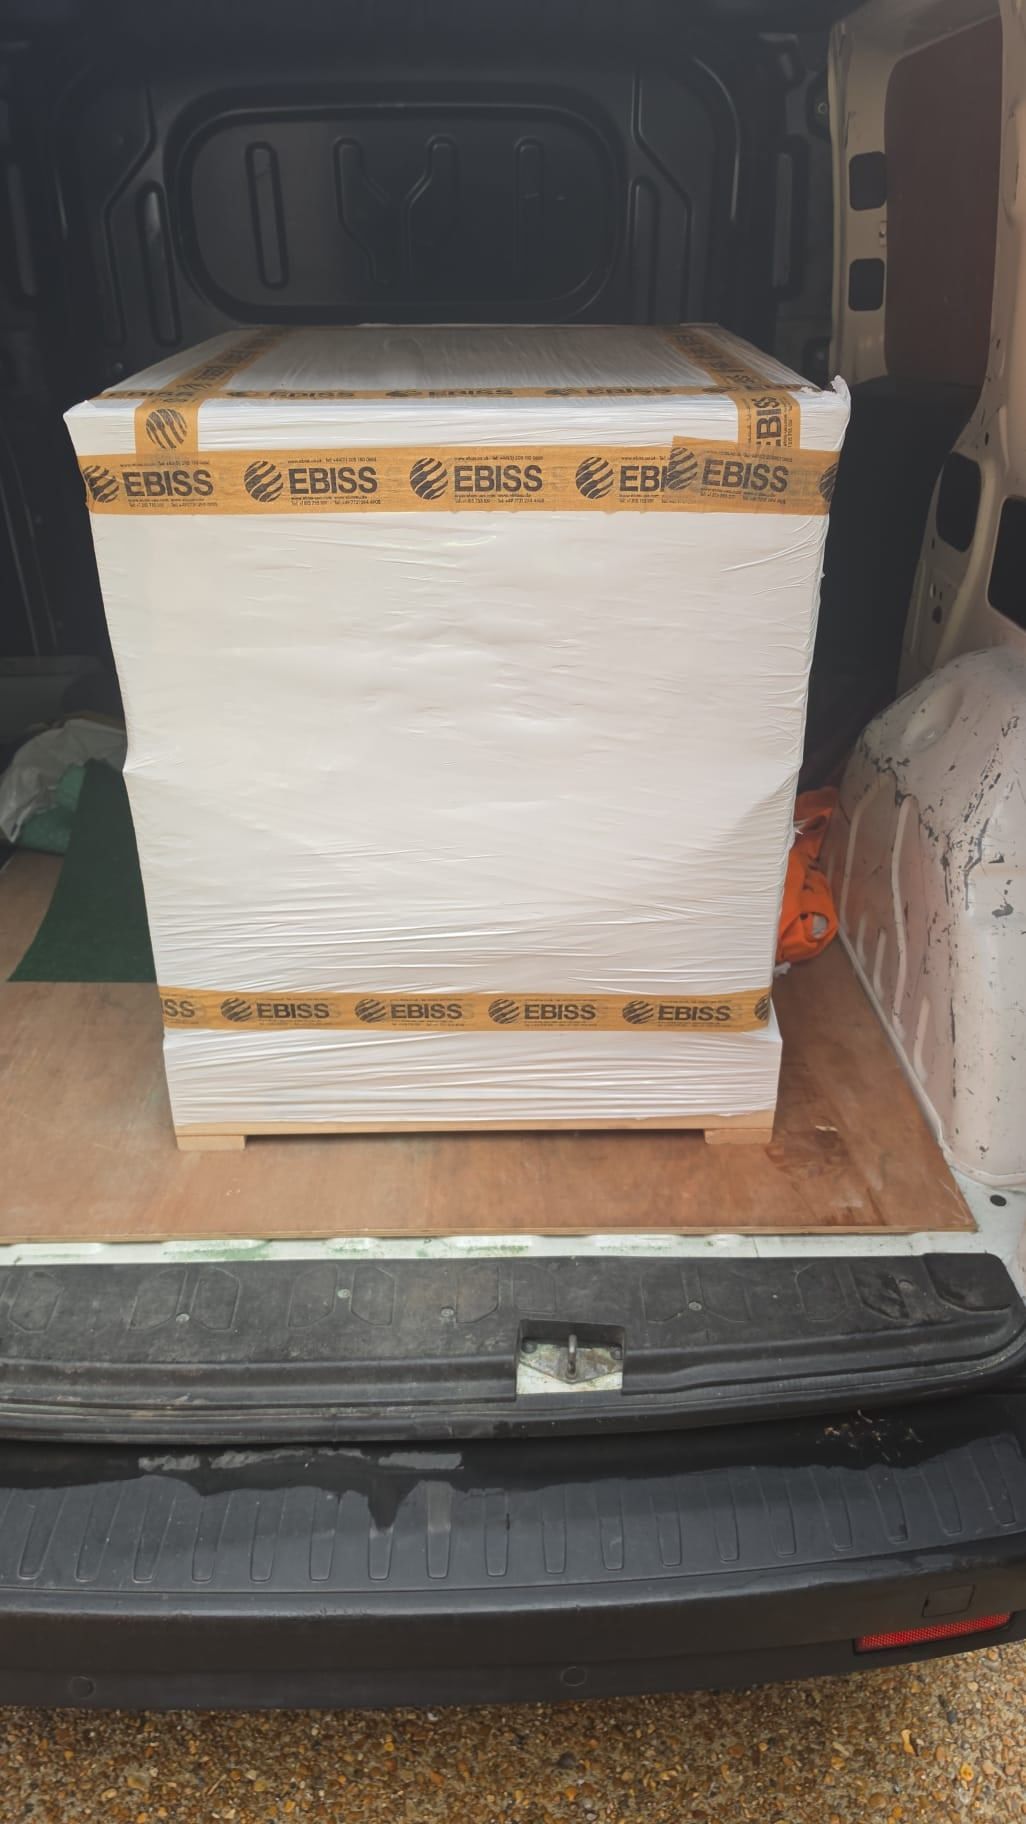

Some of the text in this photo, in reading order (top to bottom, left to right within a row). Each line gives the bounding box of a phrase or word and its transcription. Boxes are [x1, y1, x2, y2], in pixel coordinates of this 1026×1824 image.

[122, 469, 214, 497] EBISS
[288, 466, 378, 494] EBISS
[454, 464, 543, 492] EBISS
[702, 458, 789, 493] EBISS
[256, 1003, 330, 1019] EBISS
[391, 1003, 463, 1020] EBISS
[524, 1004, 596, 1020] EBISS
[657, 1005, 731, 1022] EBISS
